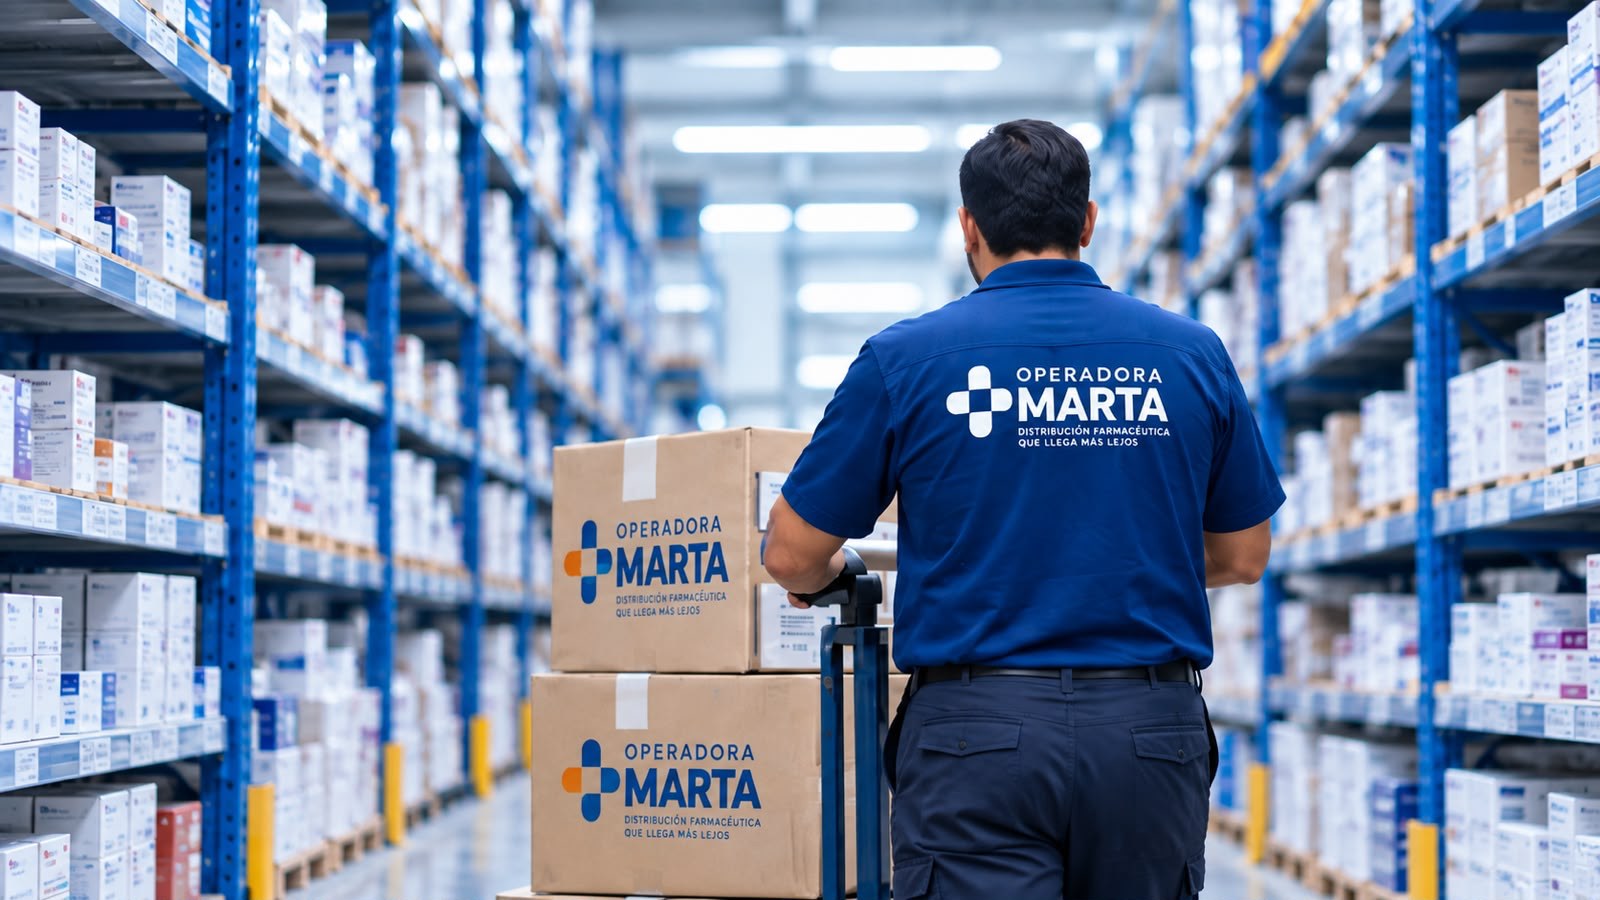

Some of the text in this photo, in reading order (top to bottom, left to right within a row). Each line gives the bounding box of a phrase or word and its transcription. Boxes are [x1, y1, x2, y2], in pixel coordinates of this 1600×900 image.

[1016, 366, 1163, 384] OPERADORA
[1017, 386, 1169, 423] MARTA
[1018, 424, 1171, 436] DISTRIBUCIÓN FARMACÉUTICA
[1018, 436, 1139, 449] QUE LLEGA MÁS LEJOS
[616, 515, 722, 540] OPERADORA
[616, 541, 730, 588] MARTA
[616, 590, 727, 604] DISTRIBUCIÓN FARMACÉUTICA
[615, 605, 700, 618] QUE LLEGA MÁS LEJOS
[624, 743, 755, 761] OPERADORA
[624, 767, 762, 810] MARTA
[624, 814, 762, 827] DISTRIBUCIÓN FARMACÉUTICA
[624, 827, 730, 840] QUE LLEGA MÁS LEJOS
